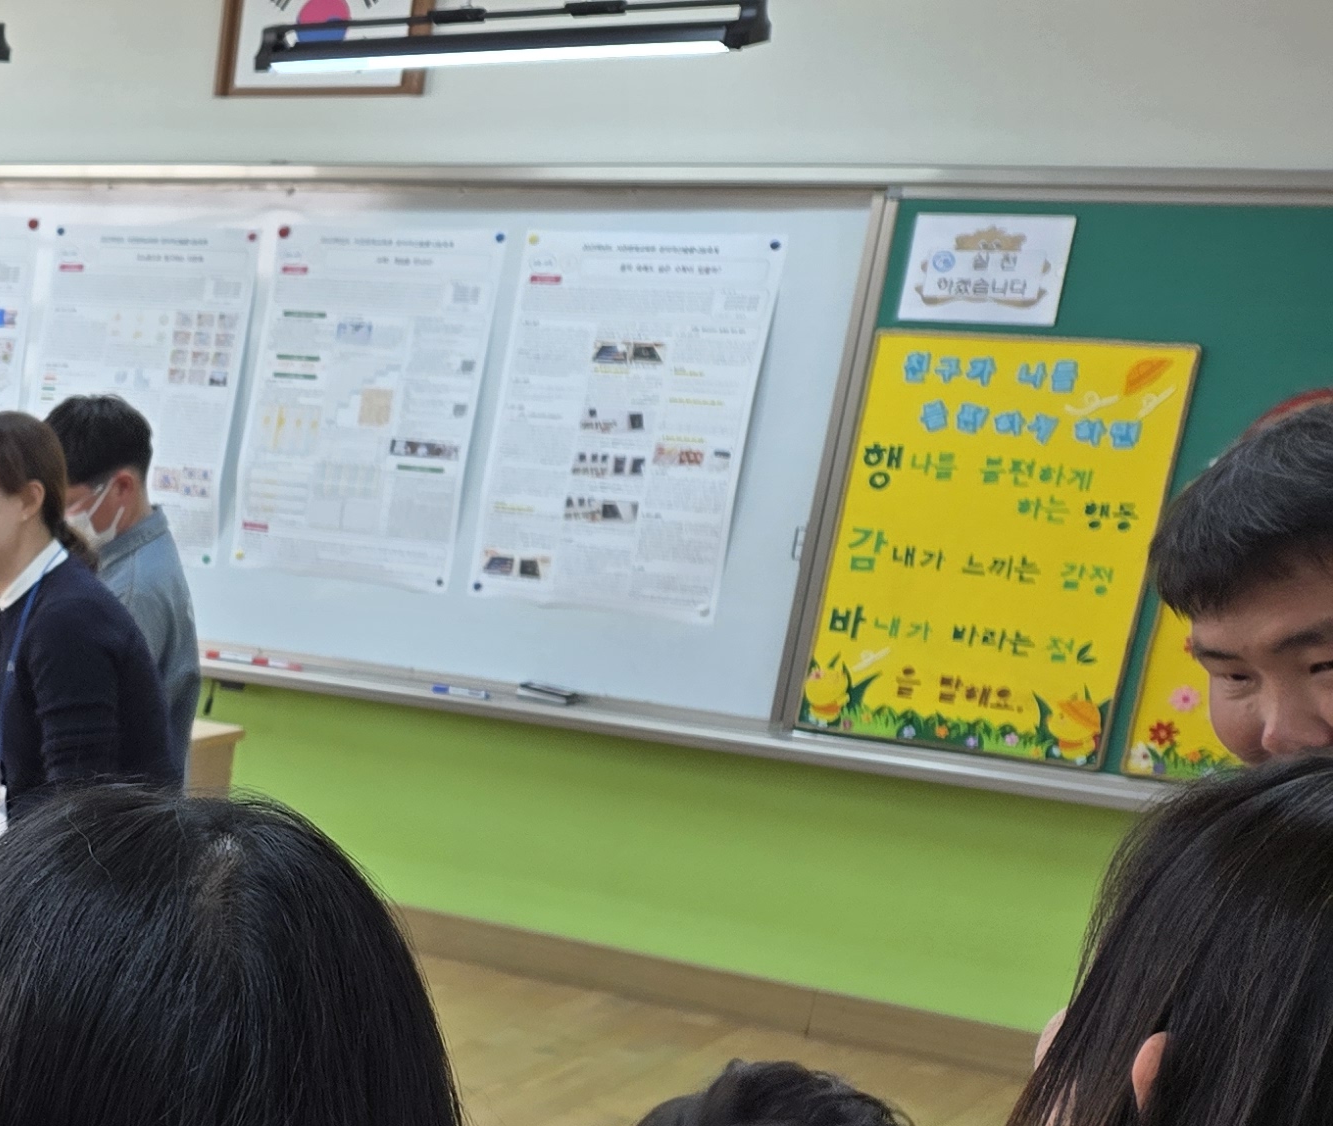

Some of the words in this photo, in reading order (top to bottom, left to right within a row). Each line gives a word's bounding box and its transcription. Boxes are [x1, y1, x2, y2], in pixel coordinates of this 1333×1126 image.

[936, 277, 1028, 297] 하겠습니다
[1017, 357, 1079, 393] 나를
[863, 442, 904, 490] 행
[911, 452, 957, 481] 나를
[980, 456, 1094, 492] 불편하게
[1017, 494, 1070, 525] 하는
[1085, 500, 1139, 531] 행동
[847, 526, 889, 573] 감
[891, 544, 946, 572] 내가
[961, 553, 1042, 585] 느끼는
[1060, 561, 1115, 596] 감정
[827, 603, 867, 640] 바
[873, 612, 931, 642] 내가
[951, 622, 1036, 657] 바라는
[895, 664, 921, 700] 을
